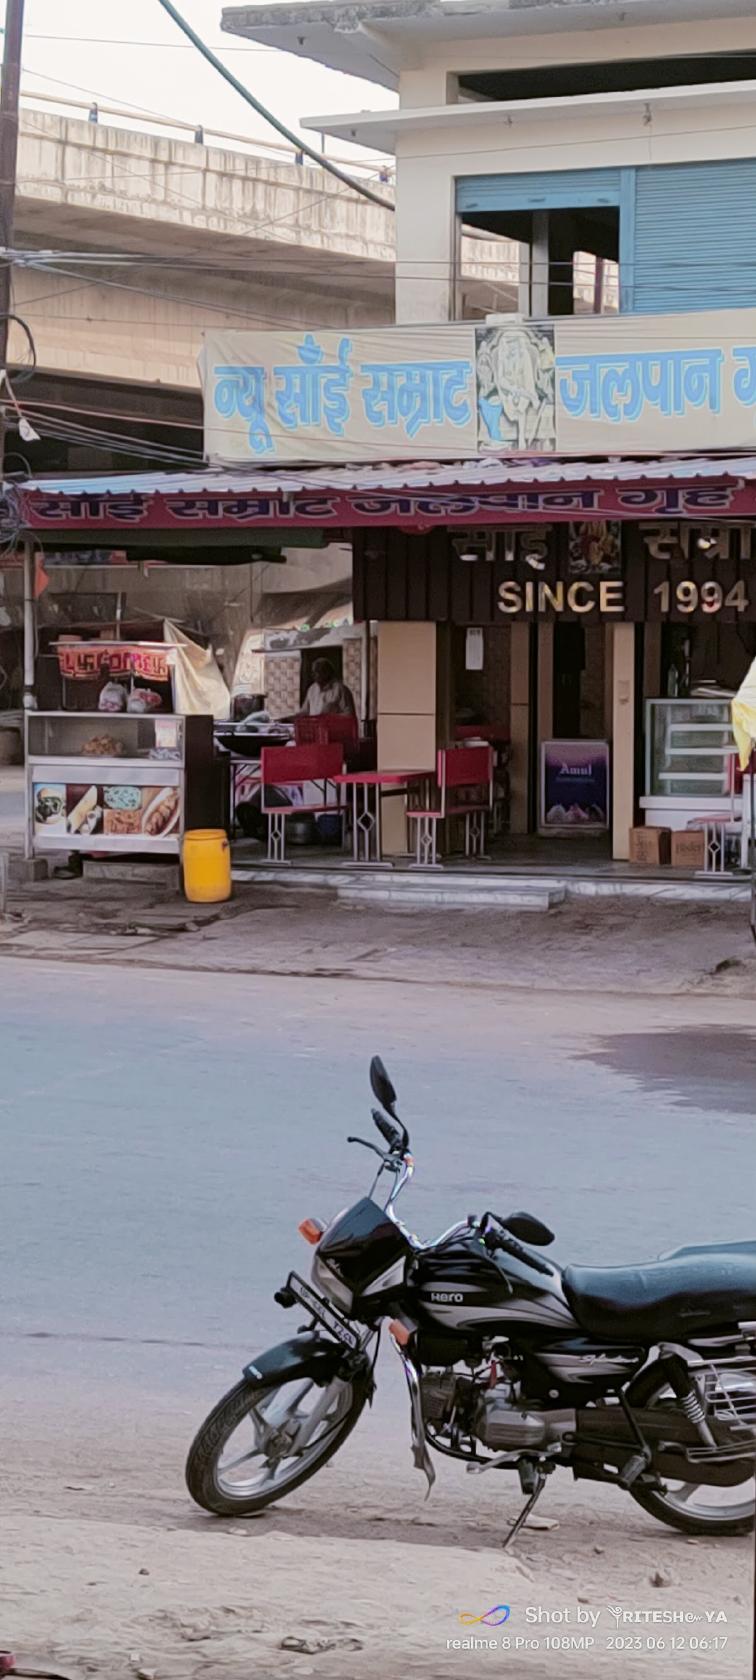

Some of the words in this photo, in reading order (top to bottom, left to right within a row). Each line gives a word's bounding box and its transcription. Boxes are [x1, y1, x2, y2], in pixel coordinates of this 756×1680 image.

[213, 365, 275, 454] न्यू
[360, 360, 472, 439] सम्राट
[555, 348, 725, 424] जलपान
[346, 489, 605, 518] जलपान
[616, 477, 745, 515] गृह
[497, 580, 626, 614] SINCE
[653, 580, 749, 614] 1994
[560, 761, 592, 776] Amul
